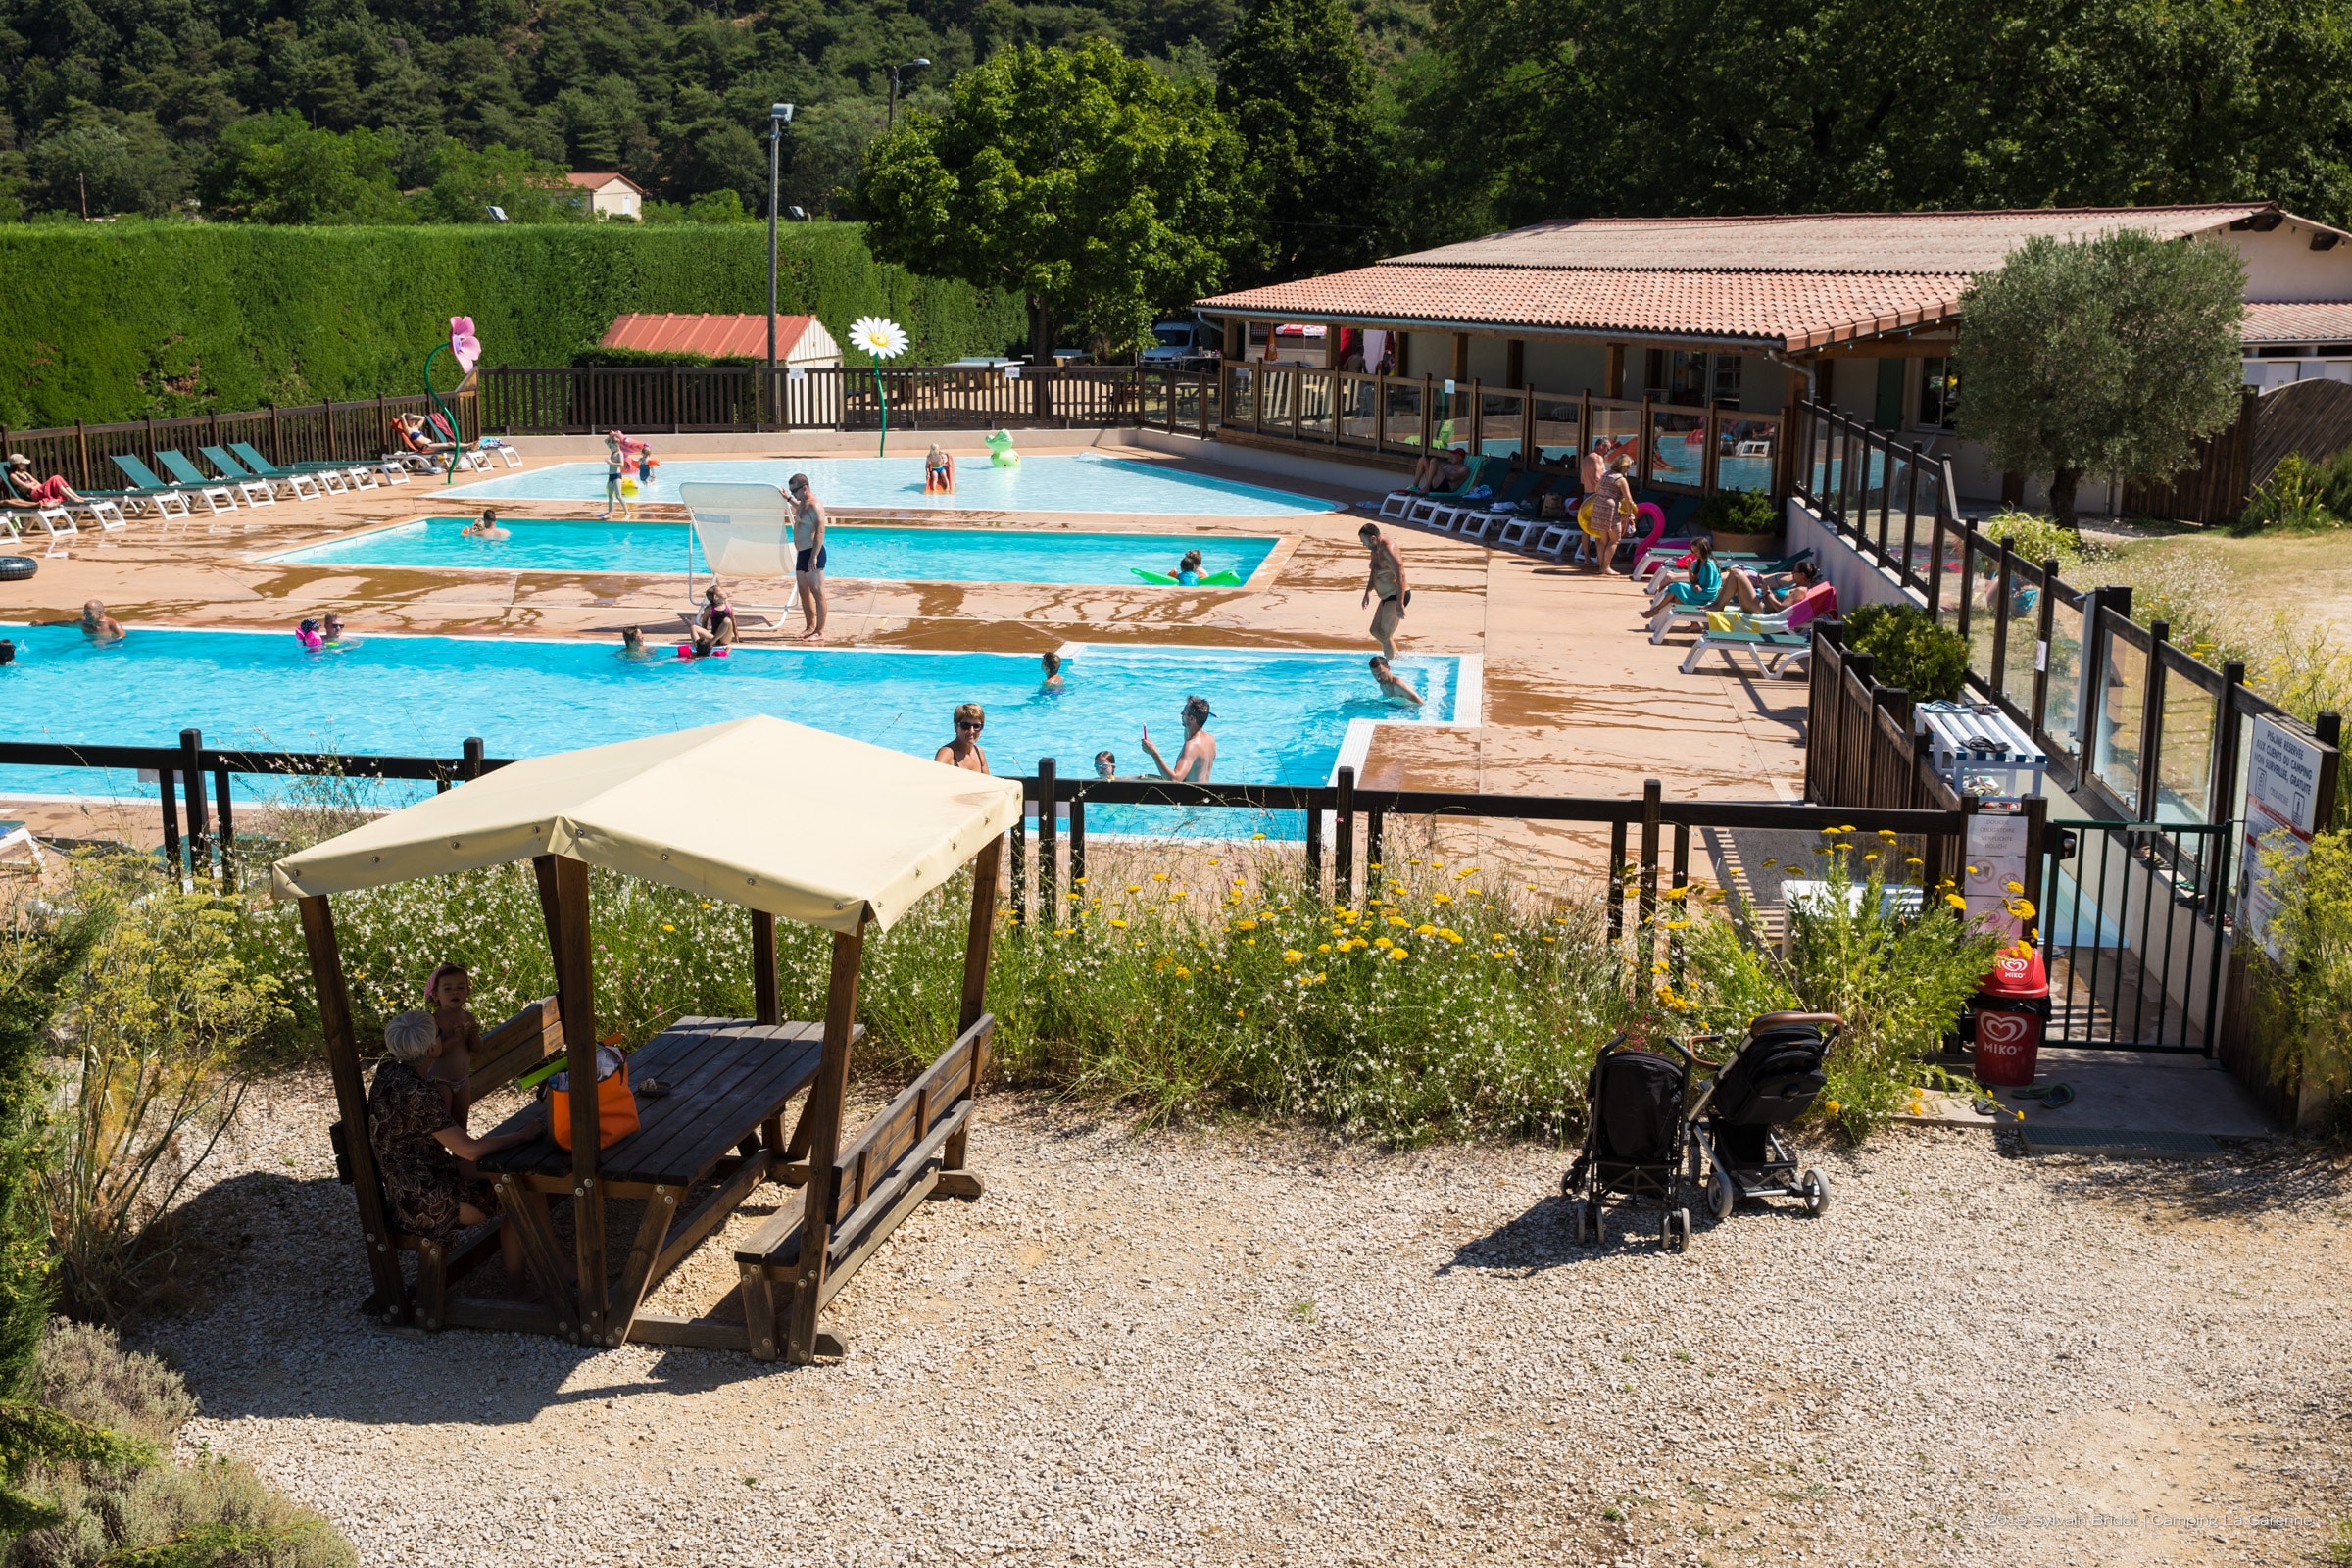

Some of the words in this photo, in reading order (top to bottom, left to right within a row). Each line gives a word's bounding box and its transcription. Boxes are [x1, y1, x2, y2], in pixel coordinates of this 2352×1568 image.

[2254, 752, 2265, 765] NON
[2290, 774, 2312, 795] GRATUITE
[2256, 739, 2266, 752] AUX
[2267, 745, 2282, 761] CLIENTS
[2283, 755, 2291, 766] DU
[2291, 760, 2312, 780] CAMPING
[1984, 1042, 2017, 1056] MIKO
